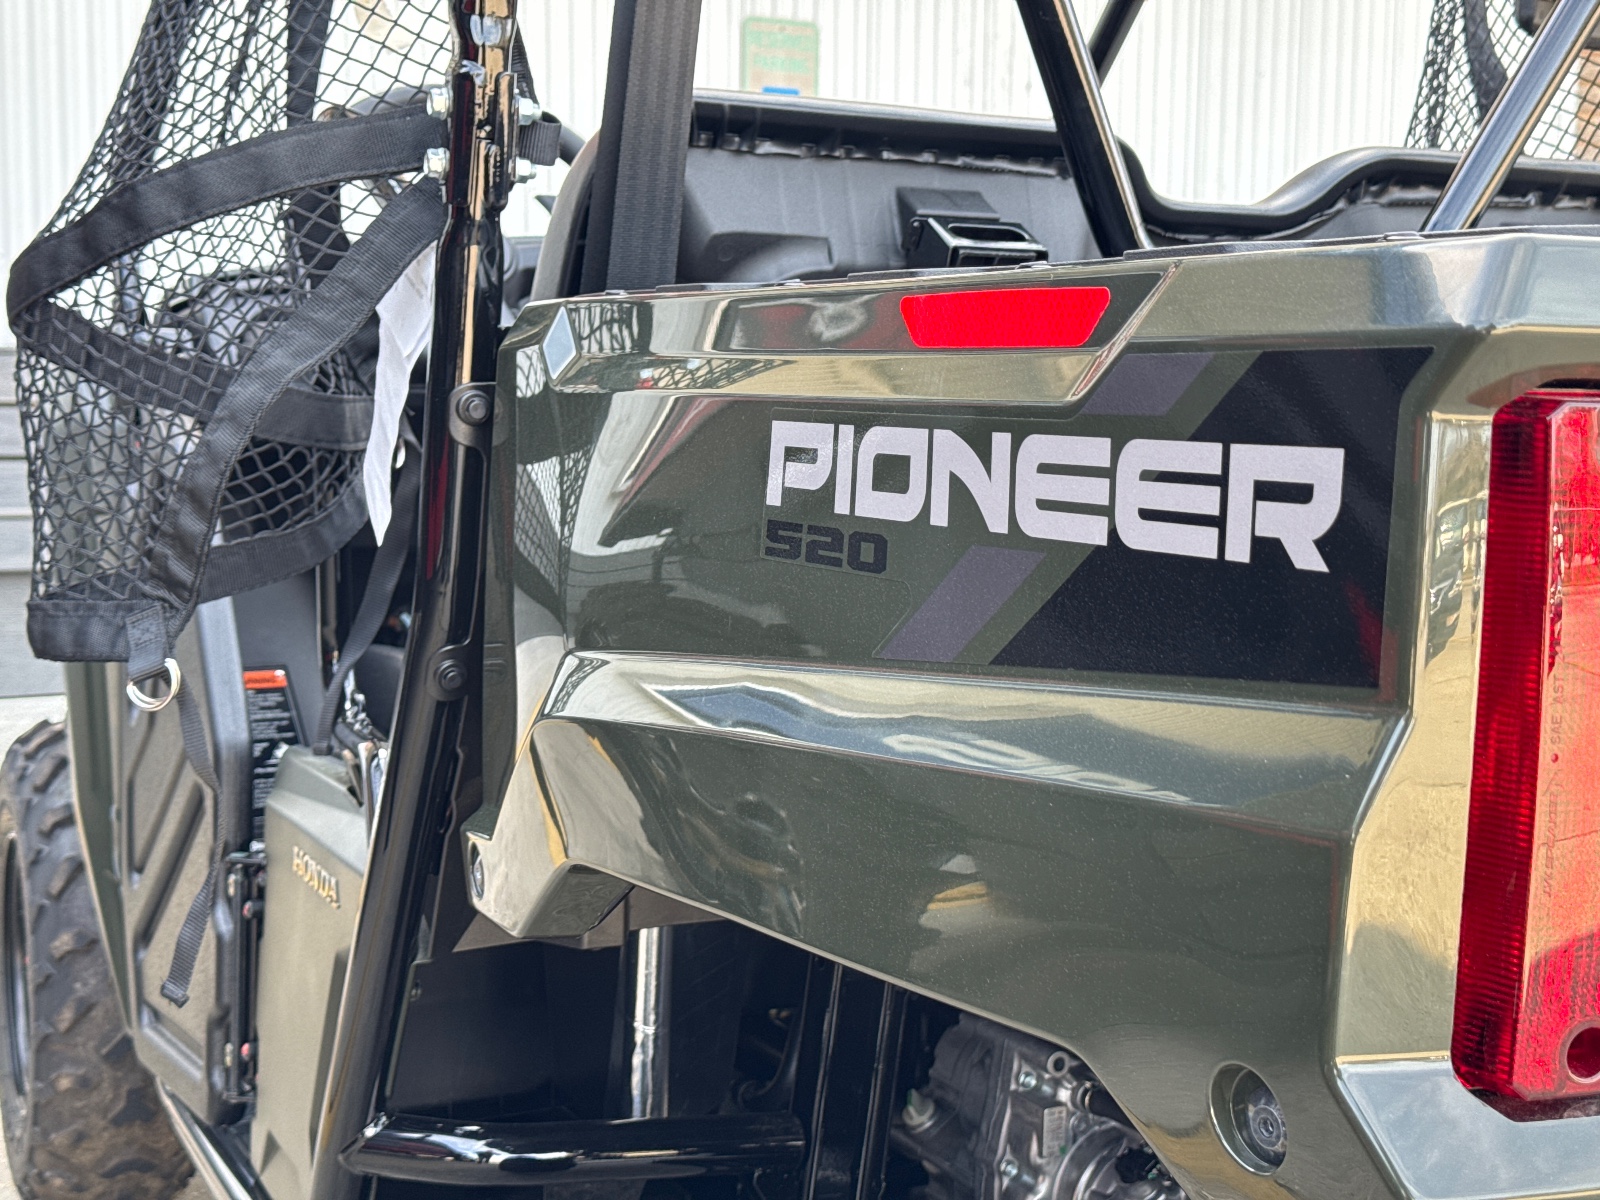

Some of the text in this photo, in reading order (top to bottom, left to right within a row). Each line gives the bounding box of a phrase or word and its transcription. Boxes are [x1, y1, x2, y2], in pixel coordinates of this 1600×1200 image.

[765, 420, 1345, 573] PIONEER
[764, 519, 888, 574] 520
[1550, 715, 1563, 745] SAE
[293, 846, 341, 909] HONDA
